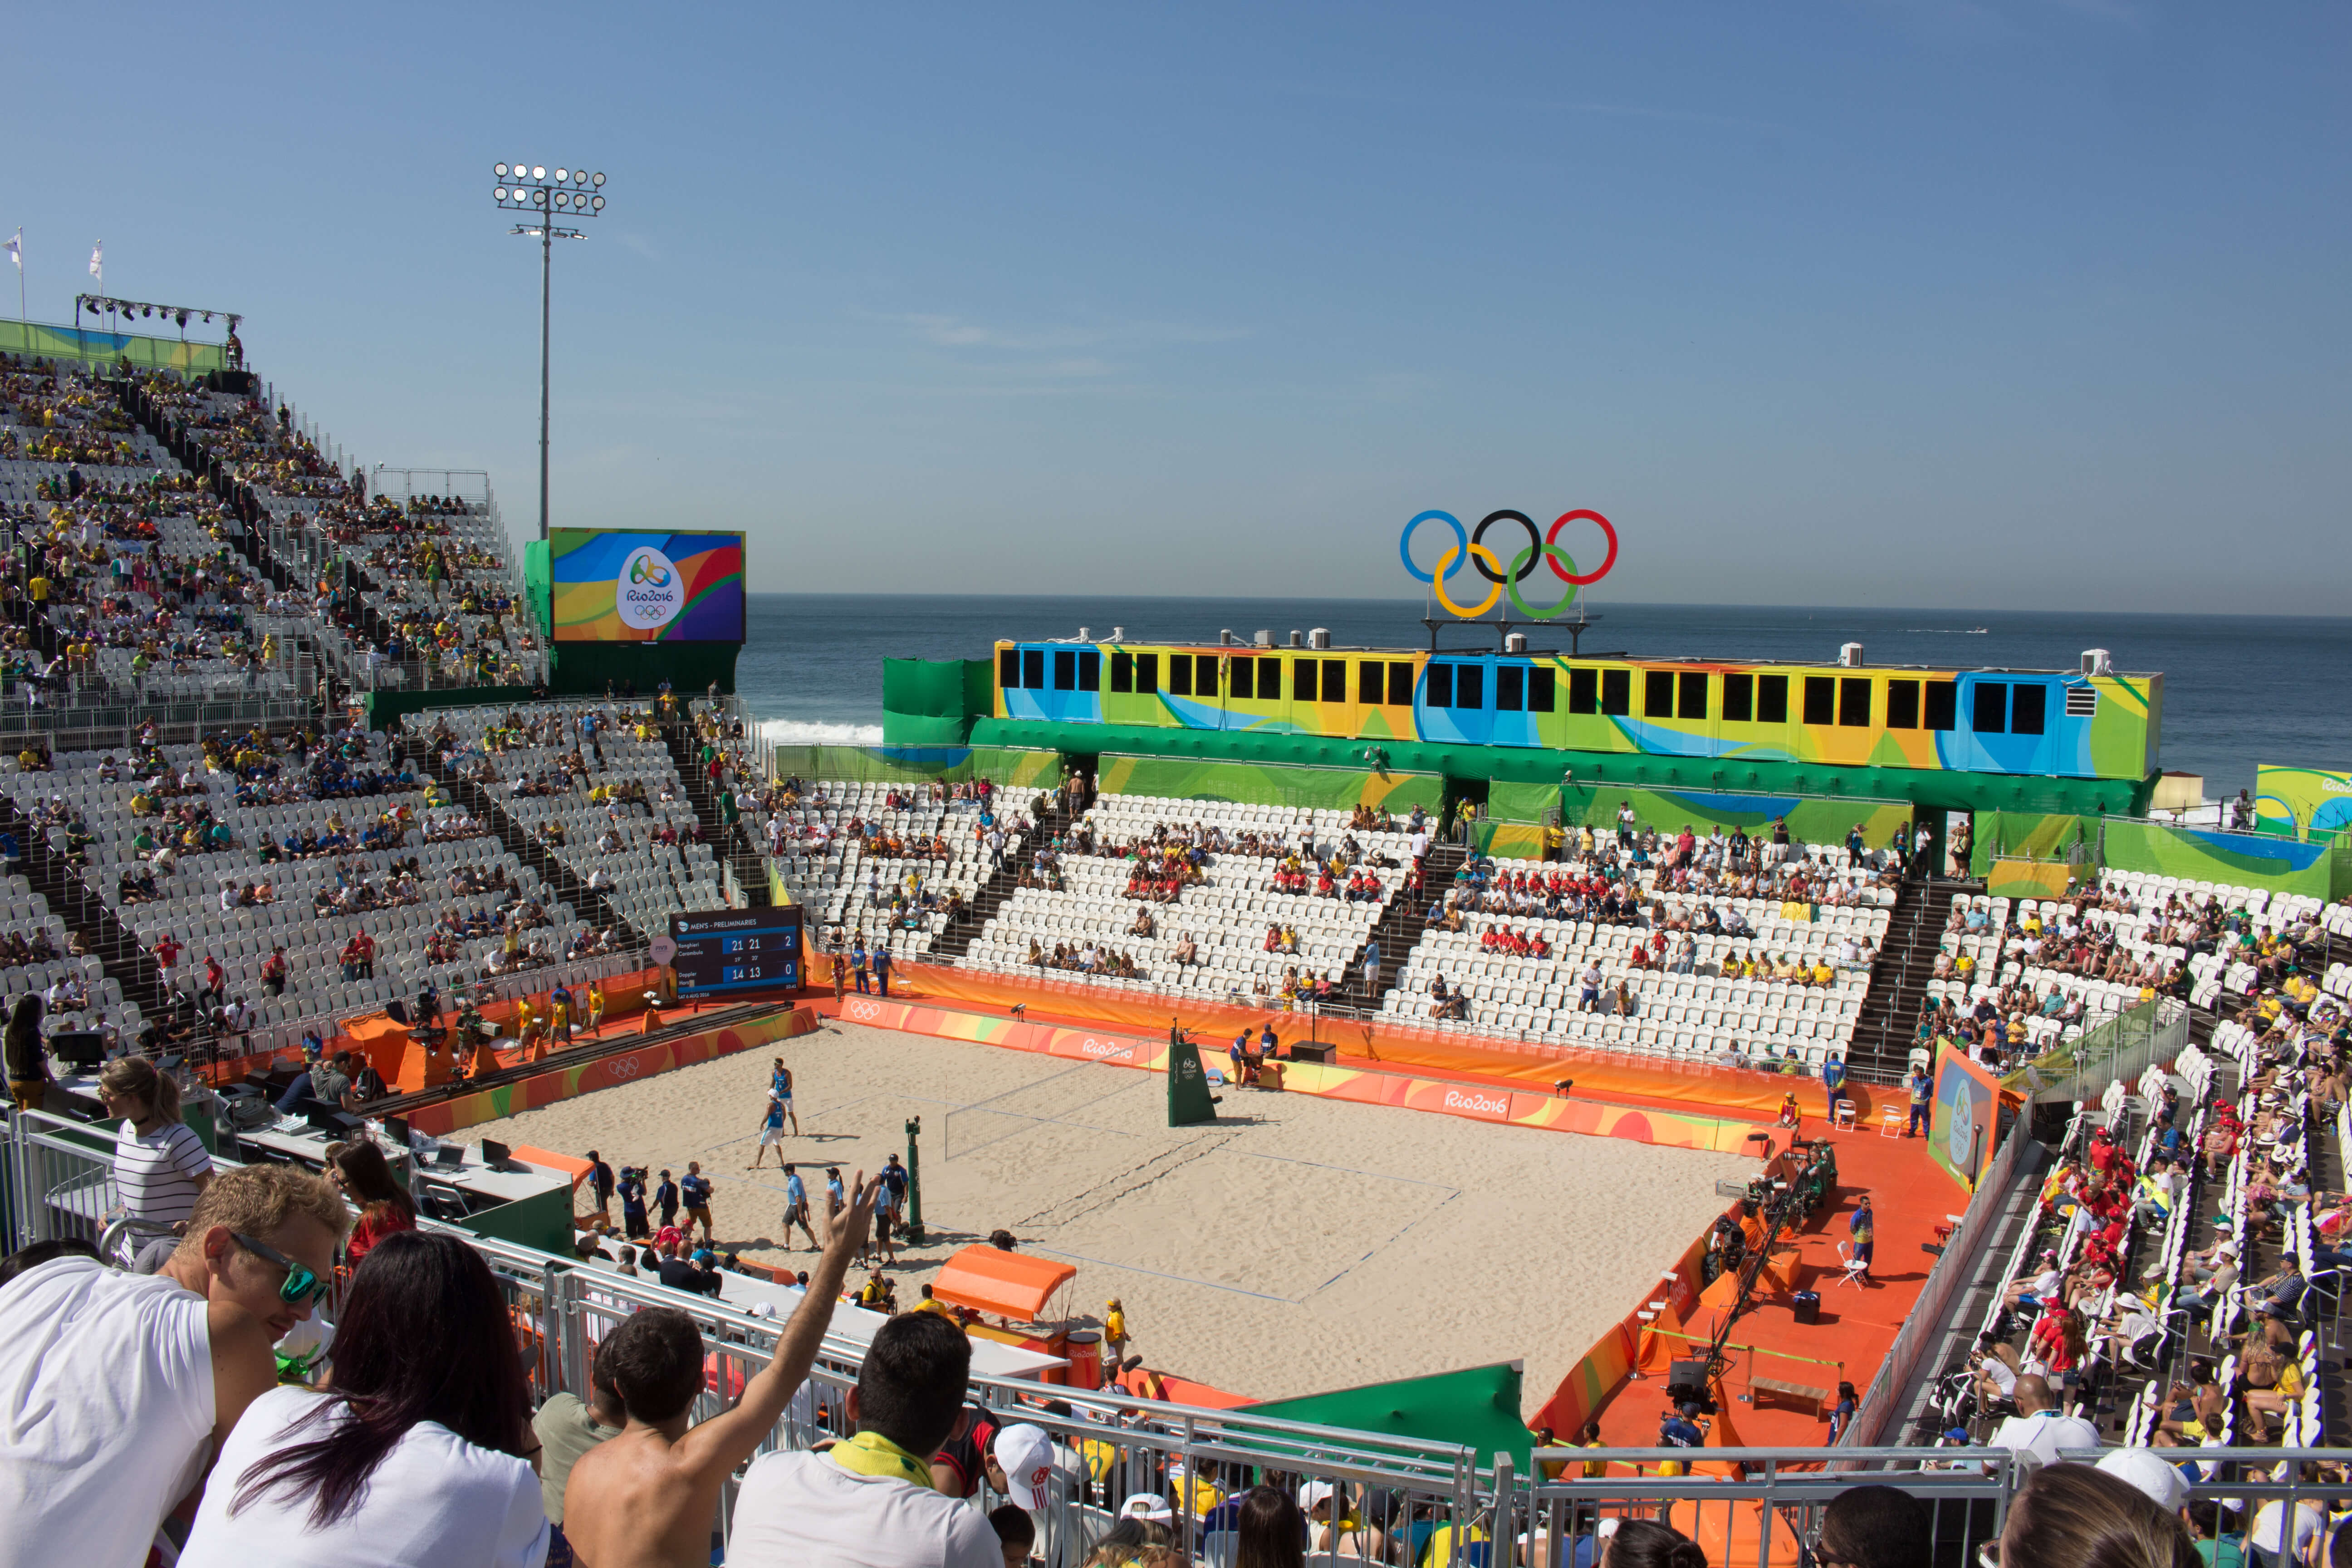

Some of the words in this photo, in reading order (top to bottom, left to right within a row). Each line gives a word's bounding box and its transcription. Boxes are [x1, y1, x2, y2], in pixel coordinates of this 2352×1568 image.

[627, 590, 673, 602] Rio2016
[714, 919, 756, 928] PRELIMINARIES
[732, 940, 744, 951] 21
[749, 938, 760, 949] 21
[785, 936, 791, 946] 2
[733, 969, 744, 979] 14
[750, 967, 760, 977] 13
[786, 964, 791, 974] 0
[1446, 1091, 1506, 1113] Rio2016
